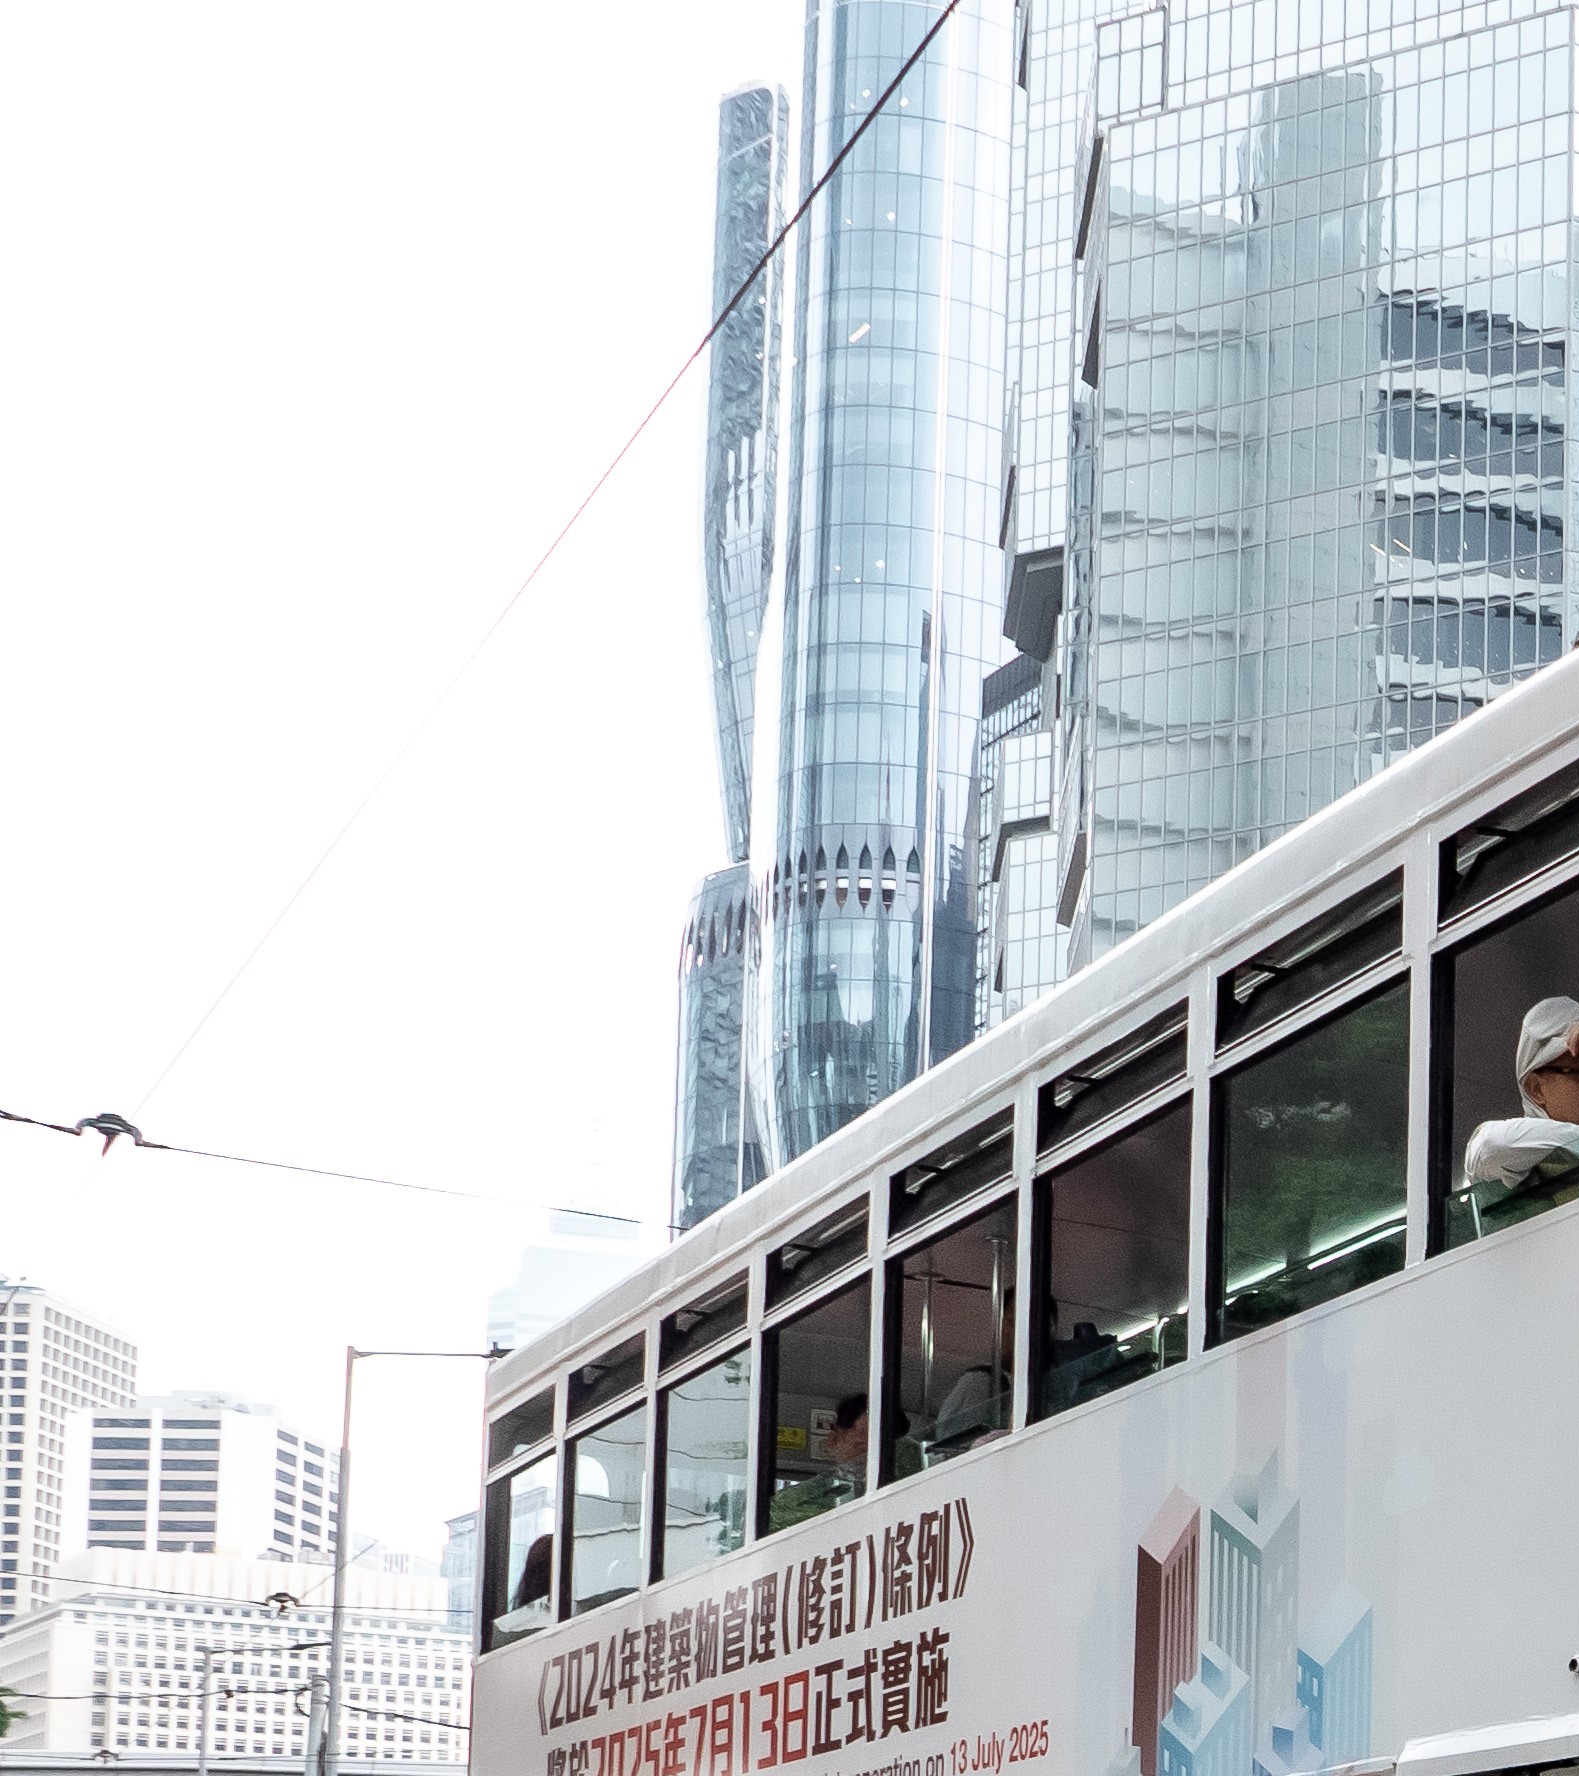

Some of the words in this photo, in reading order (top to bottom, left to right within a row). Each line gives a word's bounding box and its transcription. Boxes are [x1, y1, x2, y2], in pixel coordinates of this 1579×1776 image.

[538, 1497, 975, 1737] 《2024年建築物管理（修訂）條例》
[951, 1739, 967, 1776] 13
[971, 1731, 1005, 1775] July
[1009, 1719, 1049, 1763] 2025
